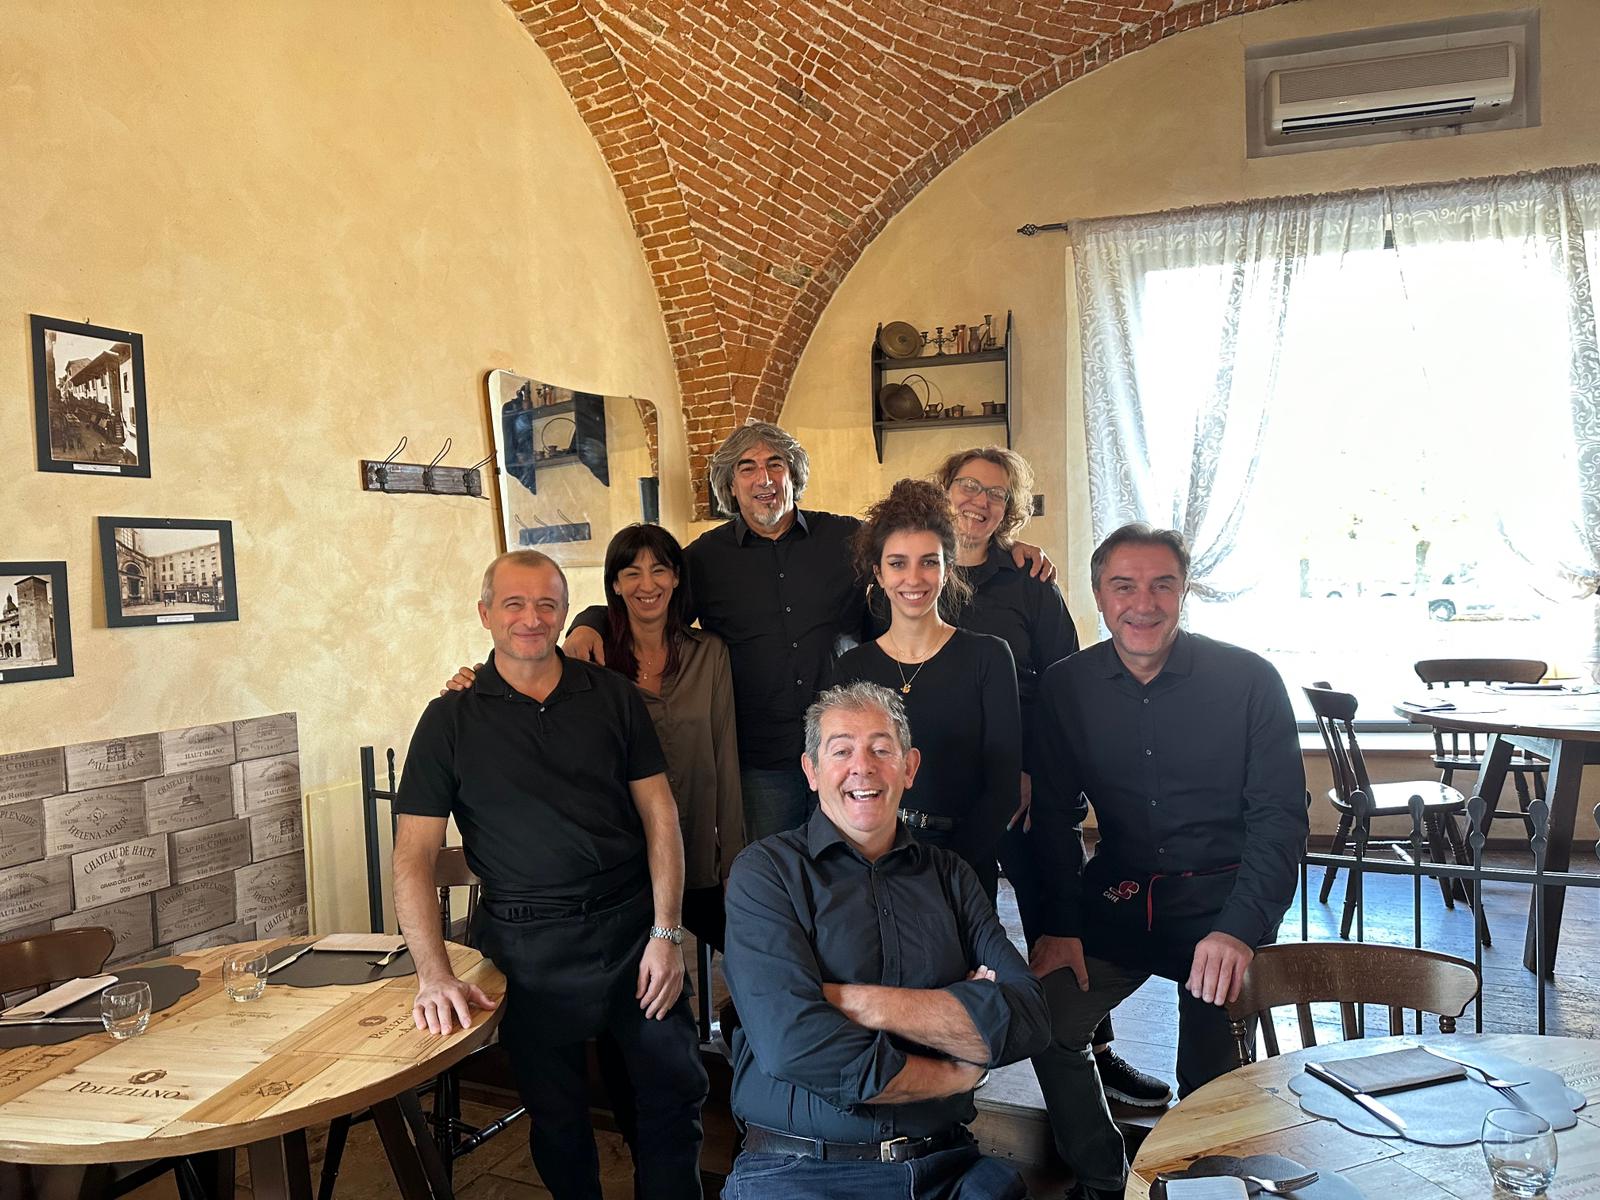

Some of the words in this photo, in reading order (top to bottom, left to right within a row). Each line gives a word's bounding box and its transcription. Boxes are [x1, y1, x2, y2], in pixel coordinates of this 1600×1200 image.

[178, 846, 195, 855] CAP
[84, 847, 119, 875] CHATEAU
[119, 845, 130, 857] DE
[131, 845, 158, 858] HAUTE
[100, 881, 118, 890] GRAND
[264, 909, 289, 933] CHATEAU
[66, 1081, 181, 1099] POLIZIANO
